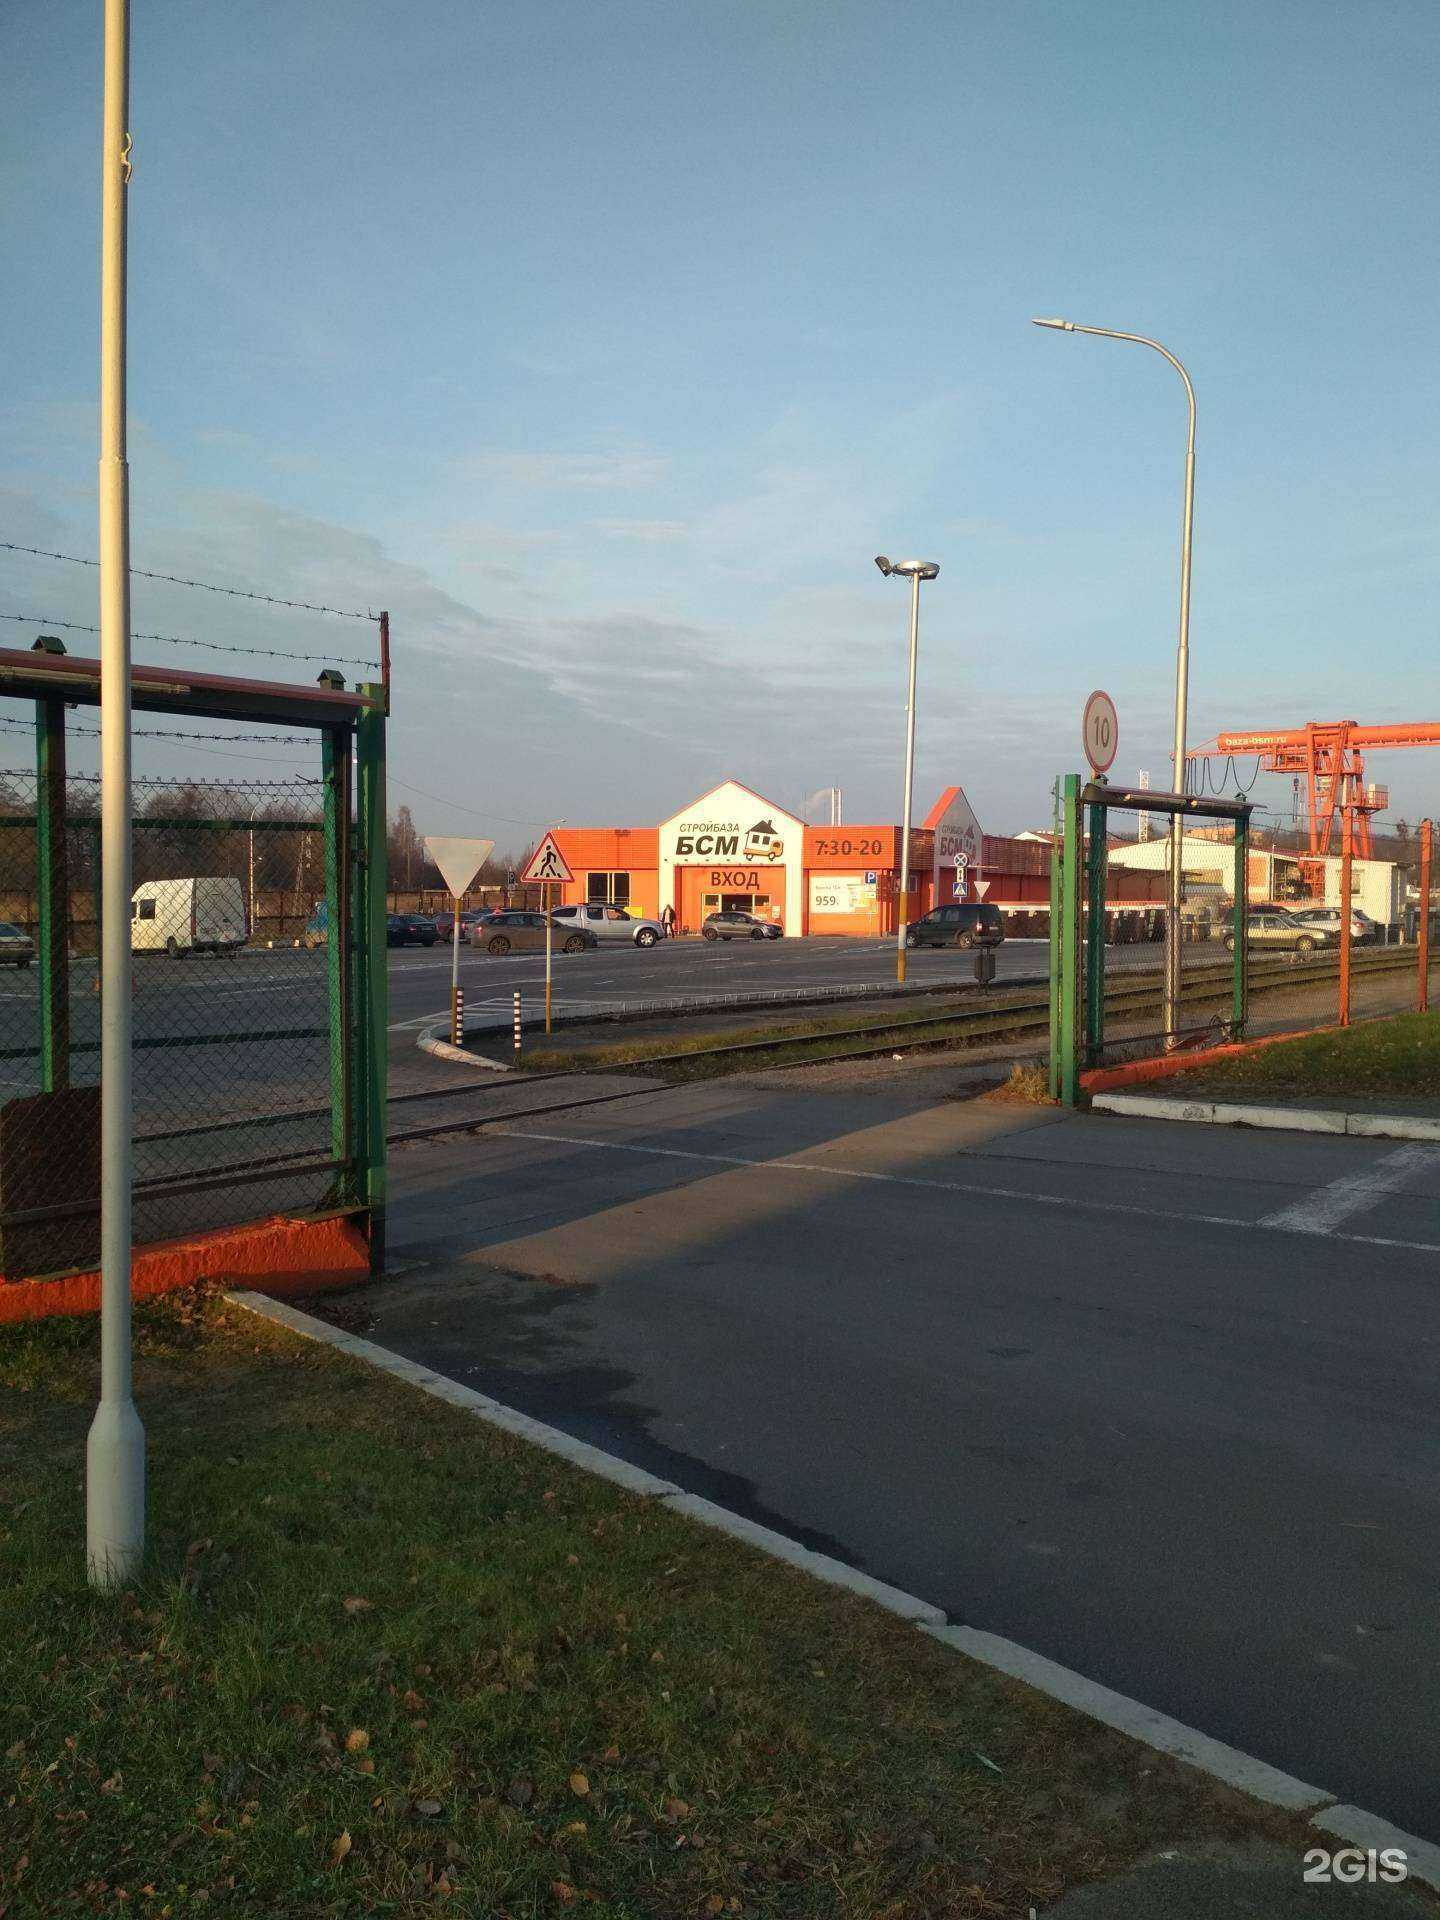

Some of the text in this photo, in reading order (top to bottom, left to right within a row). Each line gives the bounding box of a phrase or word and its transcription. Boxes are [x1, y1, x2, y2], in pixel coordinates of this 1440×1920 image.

[1094, 714, 1110, 748] 10
[679, 821, 740, 833] СТРОЙБАЗА
[675, 835, 739, 856] БСМ
[815, 839, 882, 856] 7:30-20
[711, 871, 760, 890] ВХОД
[867, 872, 875, 883] P
